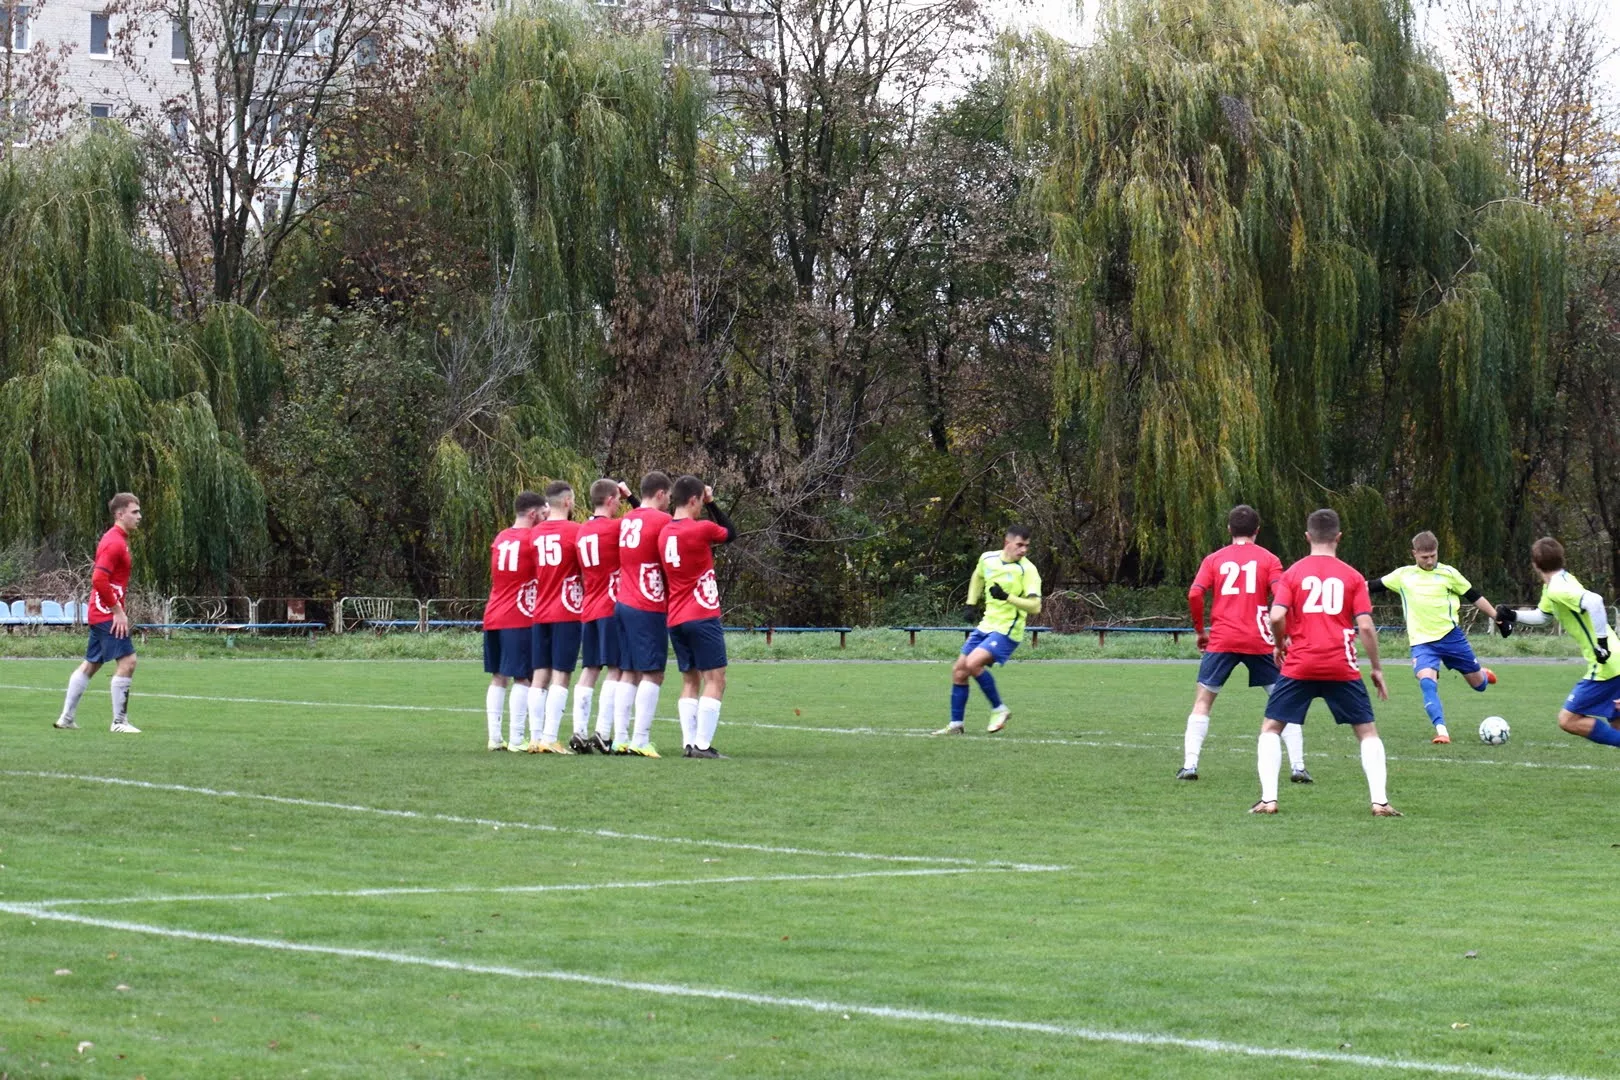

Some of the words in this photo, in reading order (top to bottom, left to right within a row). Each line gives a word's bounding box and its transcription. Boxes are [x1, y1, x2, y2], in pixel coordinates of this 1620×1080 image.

[619, 518, 642, 548] 23
[497, 540, 520, 571] 11
[534, 534, 562, 566] 15
[578, 534, 599, 567] 17
[665, 535, 680, 567] 4
[1220, 560, 1257, 595] 21
[1302, 575, 1344, 615] 20
